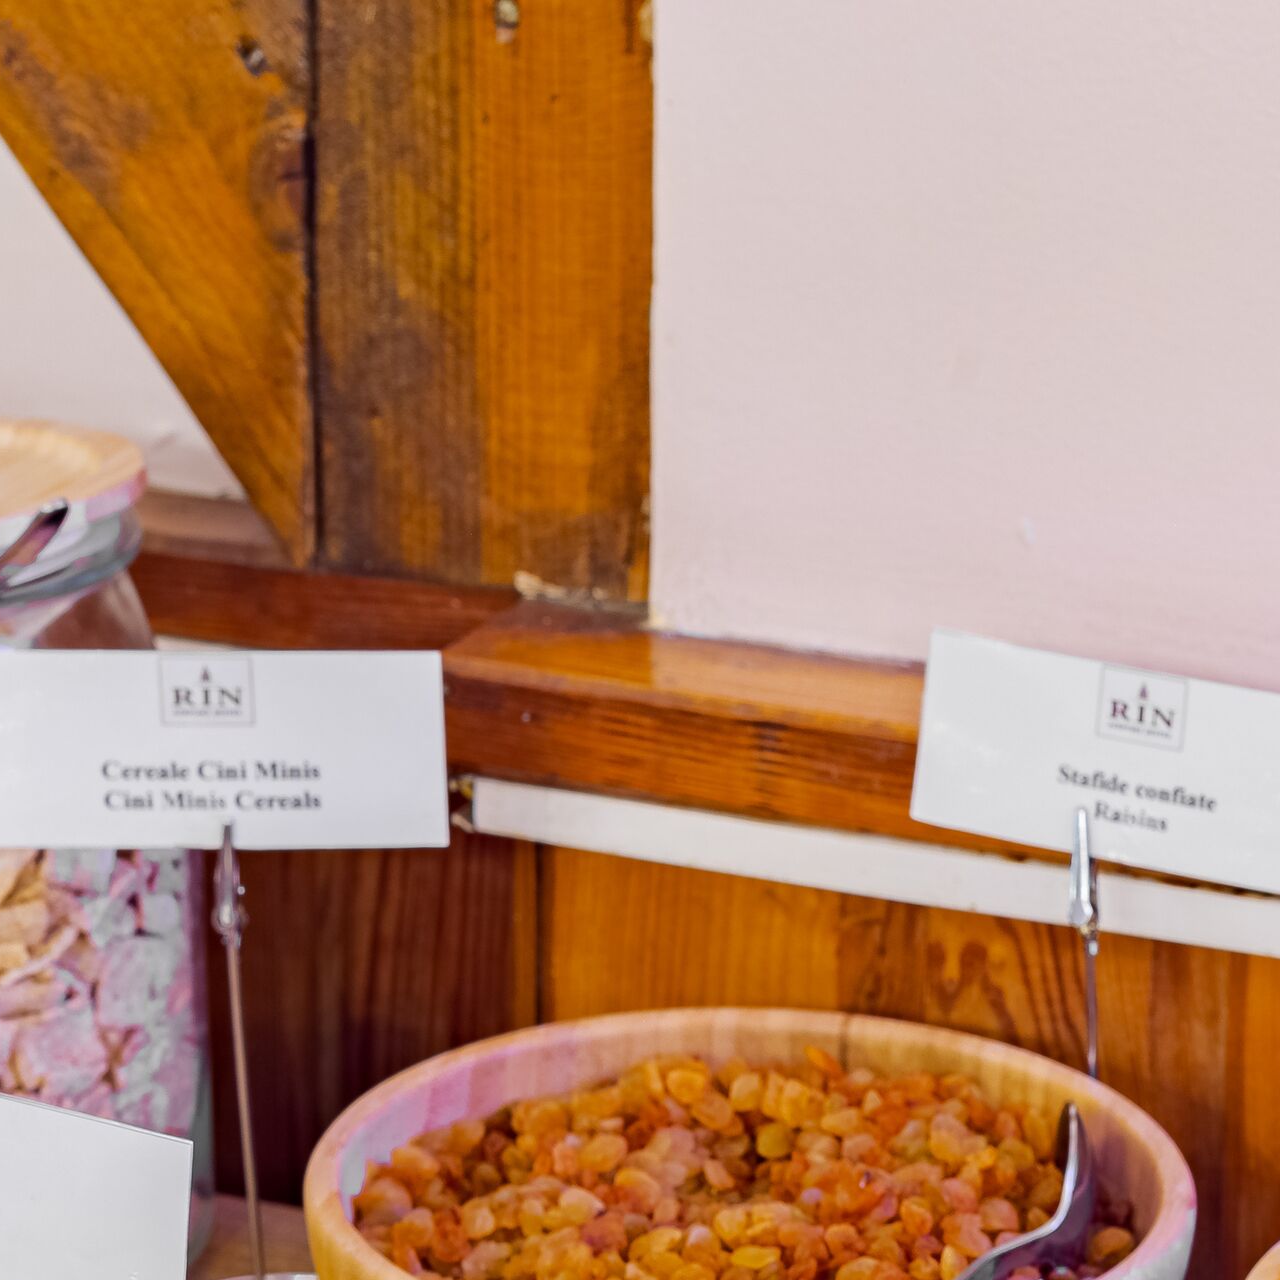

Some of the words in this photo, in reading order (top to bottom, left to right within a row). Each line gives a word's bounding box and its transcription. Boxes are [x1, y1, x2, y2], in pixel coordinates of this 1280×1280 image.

[173, 687, 243, 706] RIN
[1110, 700, 1175, 728] RIN
[101, 760, 189, 781] Cereale
[197, 760, 247, 781] Cini
[255, 761, 321, 781] Minis
[104, 790, 154, 811] Cini
[163, 791, 227, 810] Minis
[235, 791, 322, 811] Cereals
[1058, 765, 1128, 795] Stafide
[1135, 786, 1218, 812] confiate
[1094, 801, 1168, 831] Raisins
